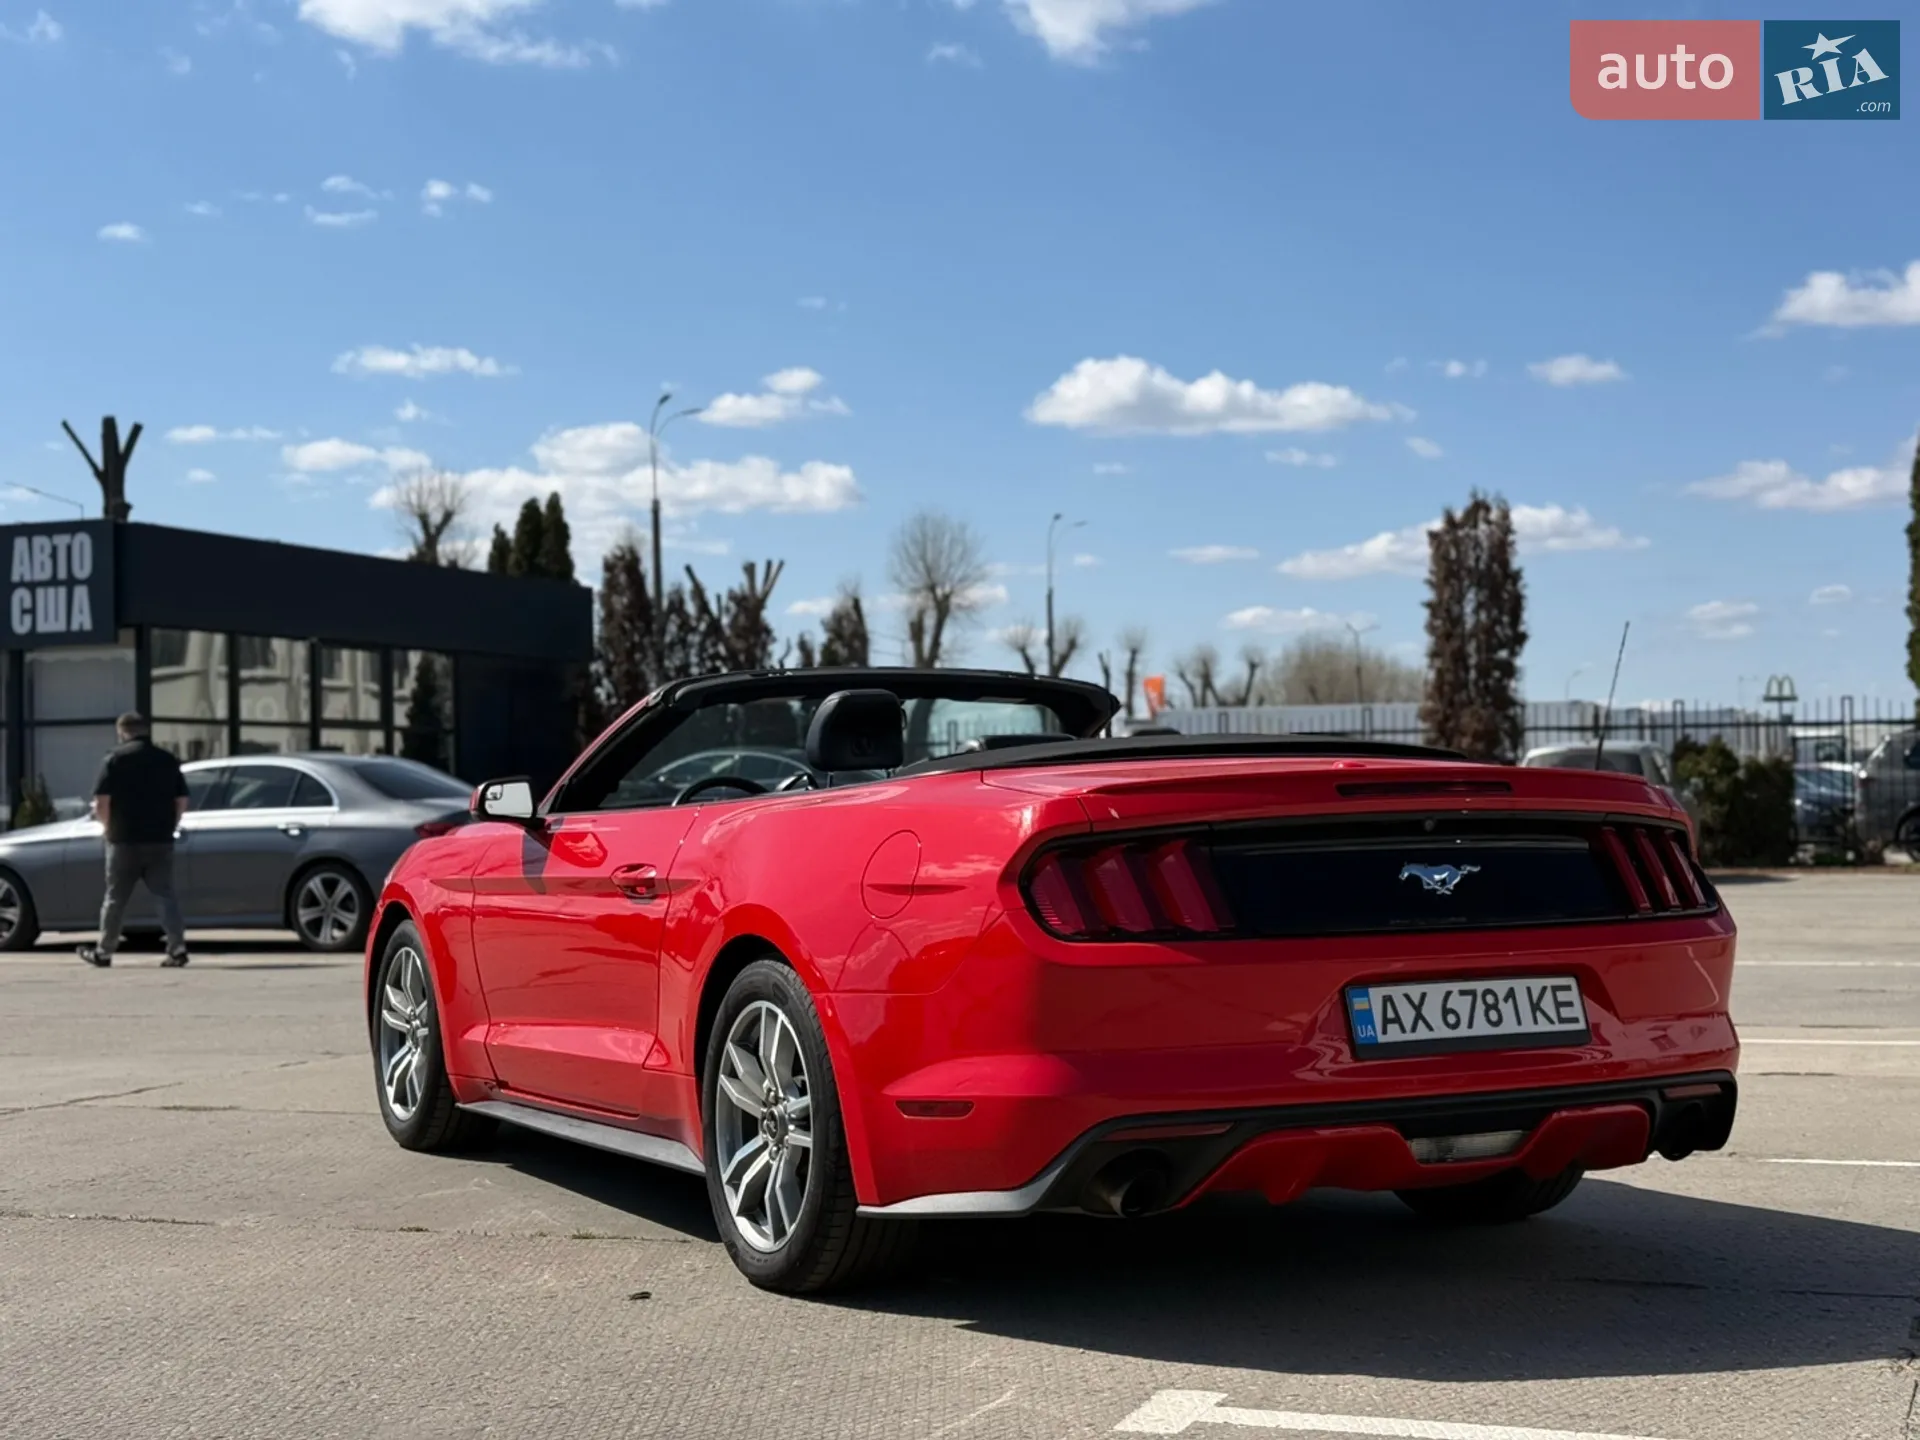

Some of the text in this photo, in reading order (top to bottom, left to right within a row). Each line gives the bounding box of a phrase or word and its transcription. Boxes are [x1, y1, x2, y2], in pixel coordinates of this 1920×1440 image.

[11, 532, 92, 582] АВТО
[11, 585, 92, 635] США
[1358, 1025, 1375, 1038] UA
[1381, 984, 1580, 1035] AX 6781 KE
